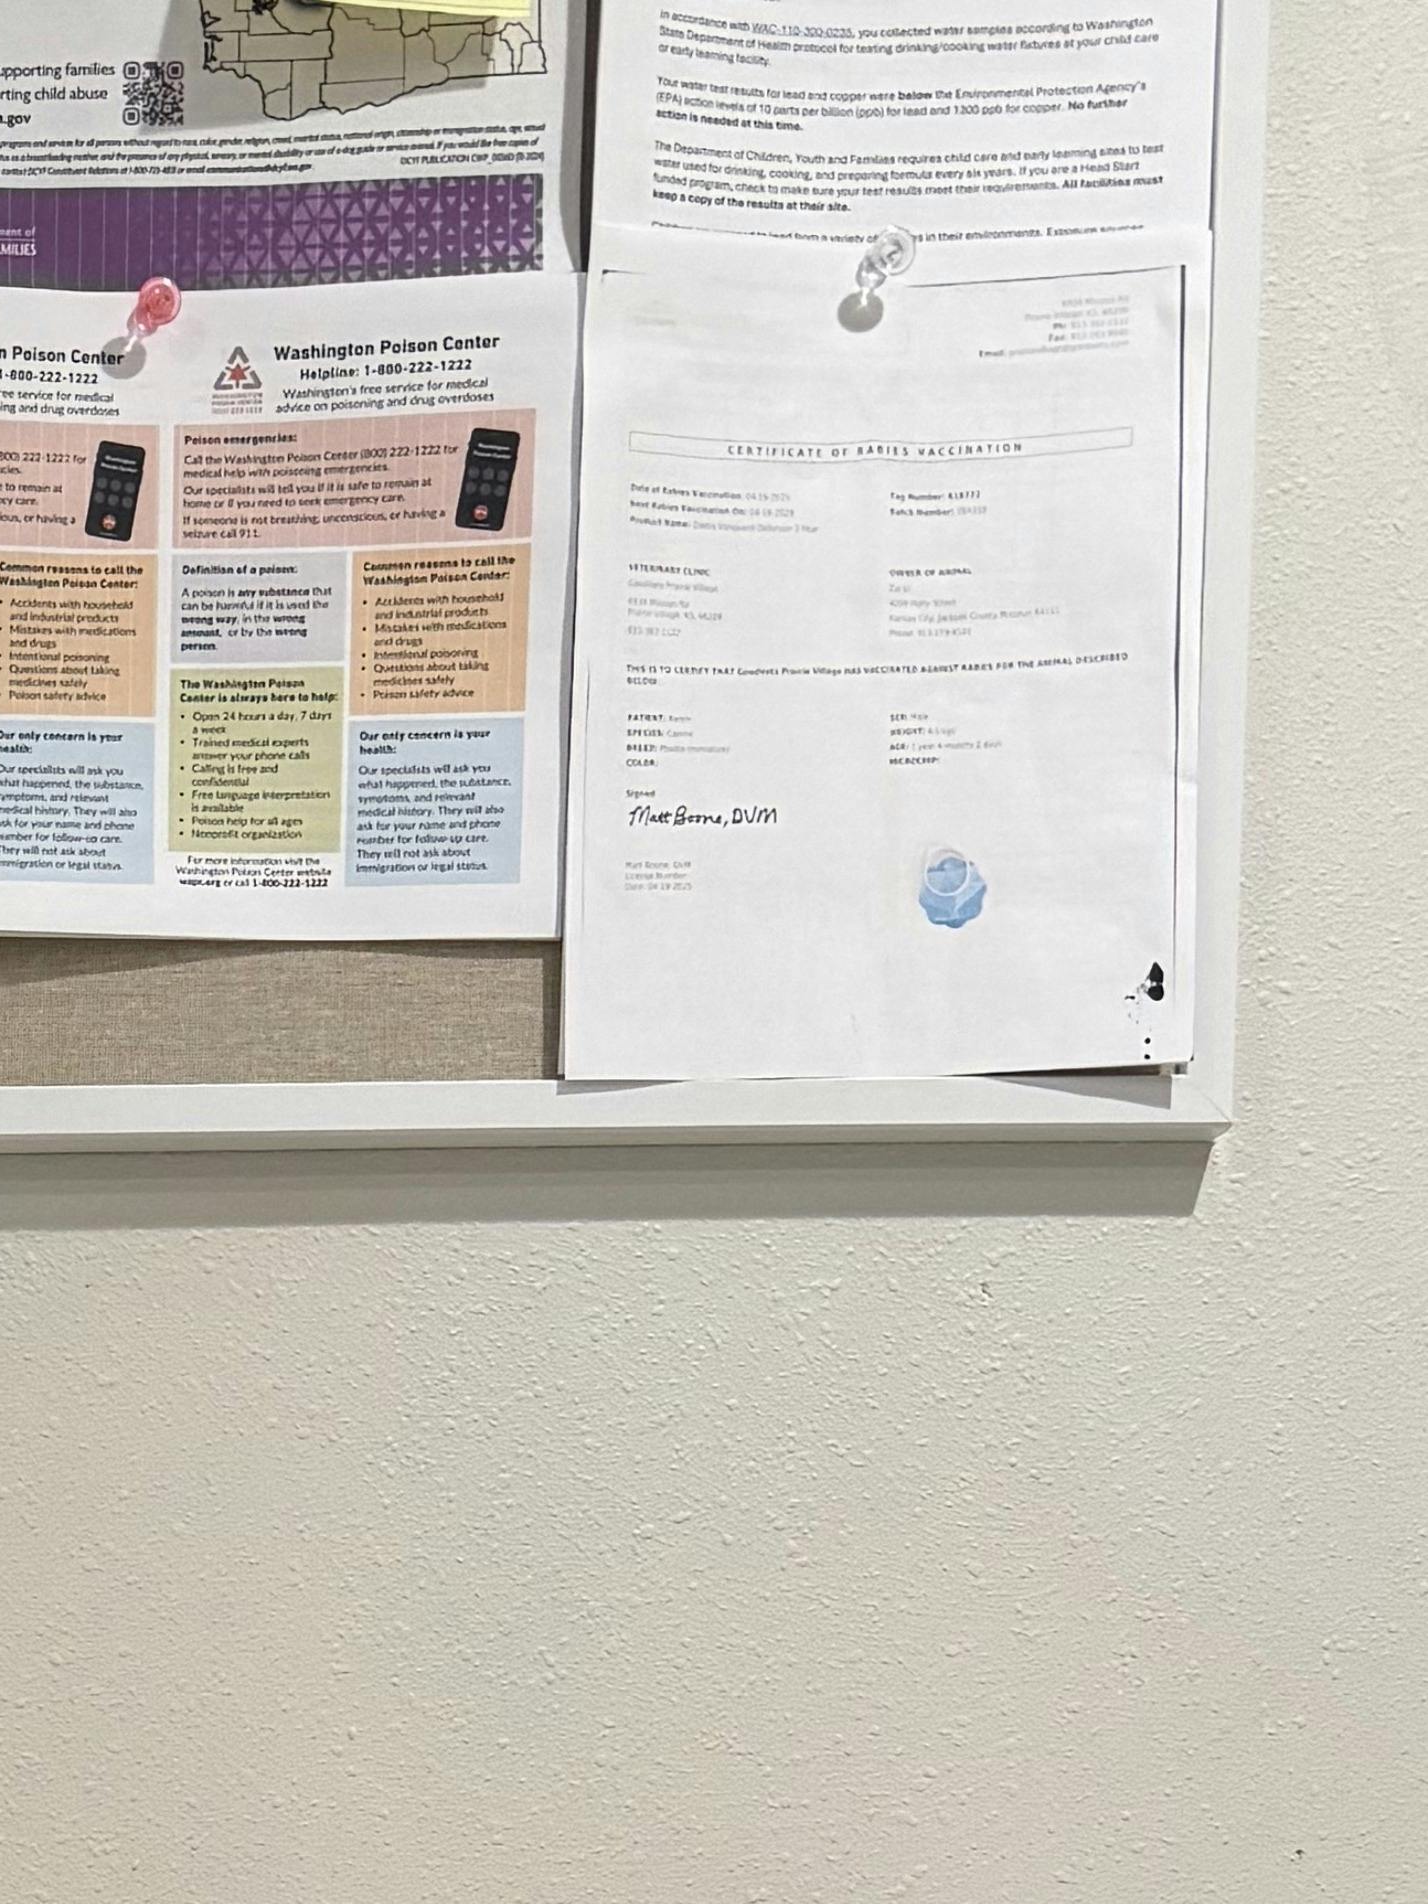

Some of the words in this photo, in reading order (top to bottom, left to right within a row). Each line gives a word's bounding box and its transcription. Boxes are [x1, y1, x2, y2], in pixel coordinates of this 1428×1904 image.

[64, 61, 116, 77] families
[33, 85, 66, 101] child
[68, 85, 109, 100] abuse
[652, 188, 678, 203] keep
[687, 194, 713, 207] copy
[713, 195, 726, 207] of
[726, 197, 745, 209] the
[746, 199, 785, 211] results
[785, 201, 798, 211] at
[799, 200, 826, 212] their
[826, 201, 852, 213] site.
[24, 226, 37, 238] of
[12, 345, 66, 363] Poison
[70, 349, 125, 366] Center
[273, 342, 375, 361] Washington
[380, 338, 438, 355] Poison
[442, 335, 501, 352] Center
[299, 366, 360, 382] Helpline:
[359, 384, 383, 396] free
[384, 382, 425, 394] service
[426, 379, 444, 392] for
[445, 376, 489, 391] medical
[17, 390, 54, 402] service
[55, 390, 72, 402] for
[74, 391, 115, 404] medical
[275, 402, 312, 415] advice
[313, 402, 329, 413] on
[330, 398, 385, 414] poisoning
[386, 395, 408, 408] and
[409, 395, 436, 408] drug
[437, 392, 495, 405] overdoses
[18, 402, 39, 414] and
[39, 403, 65, 417] drug
[66, 405, 121, 417] overdoses
[727, 445, 822, 458] CERTIFICATE
[917, 442, 1022, 457] VACCINATION
[628, 804, 671, 828] Matt
[731, 805, 778, 825] DVM
